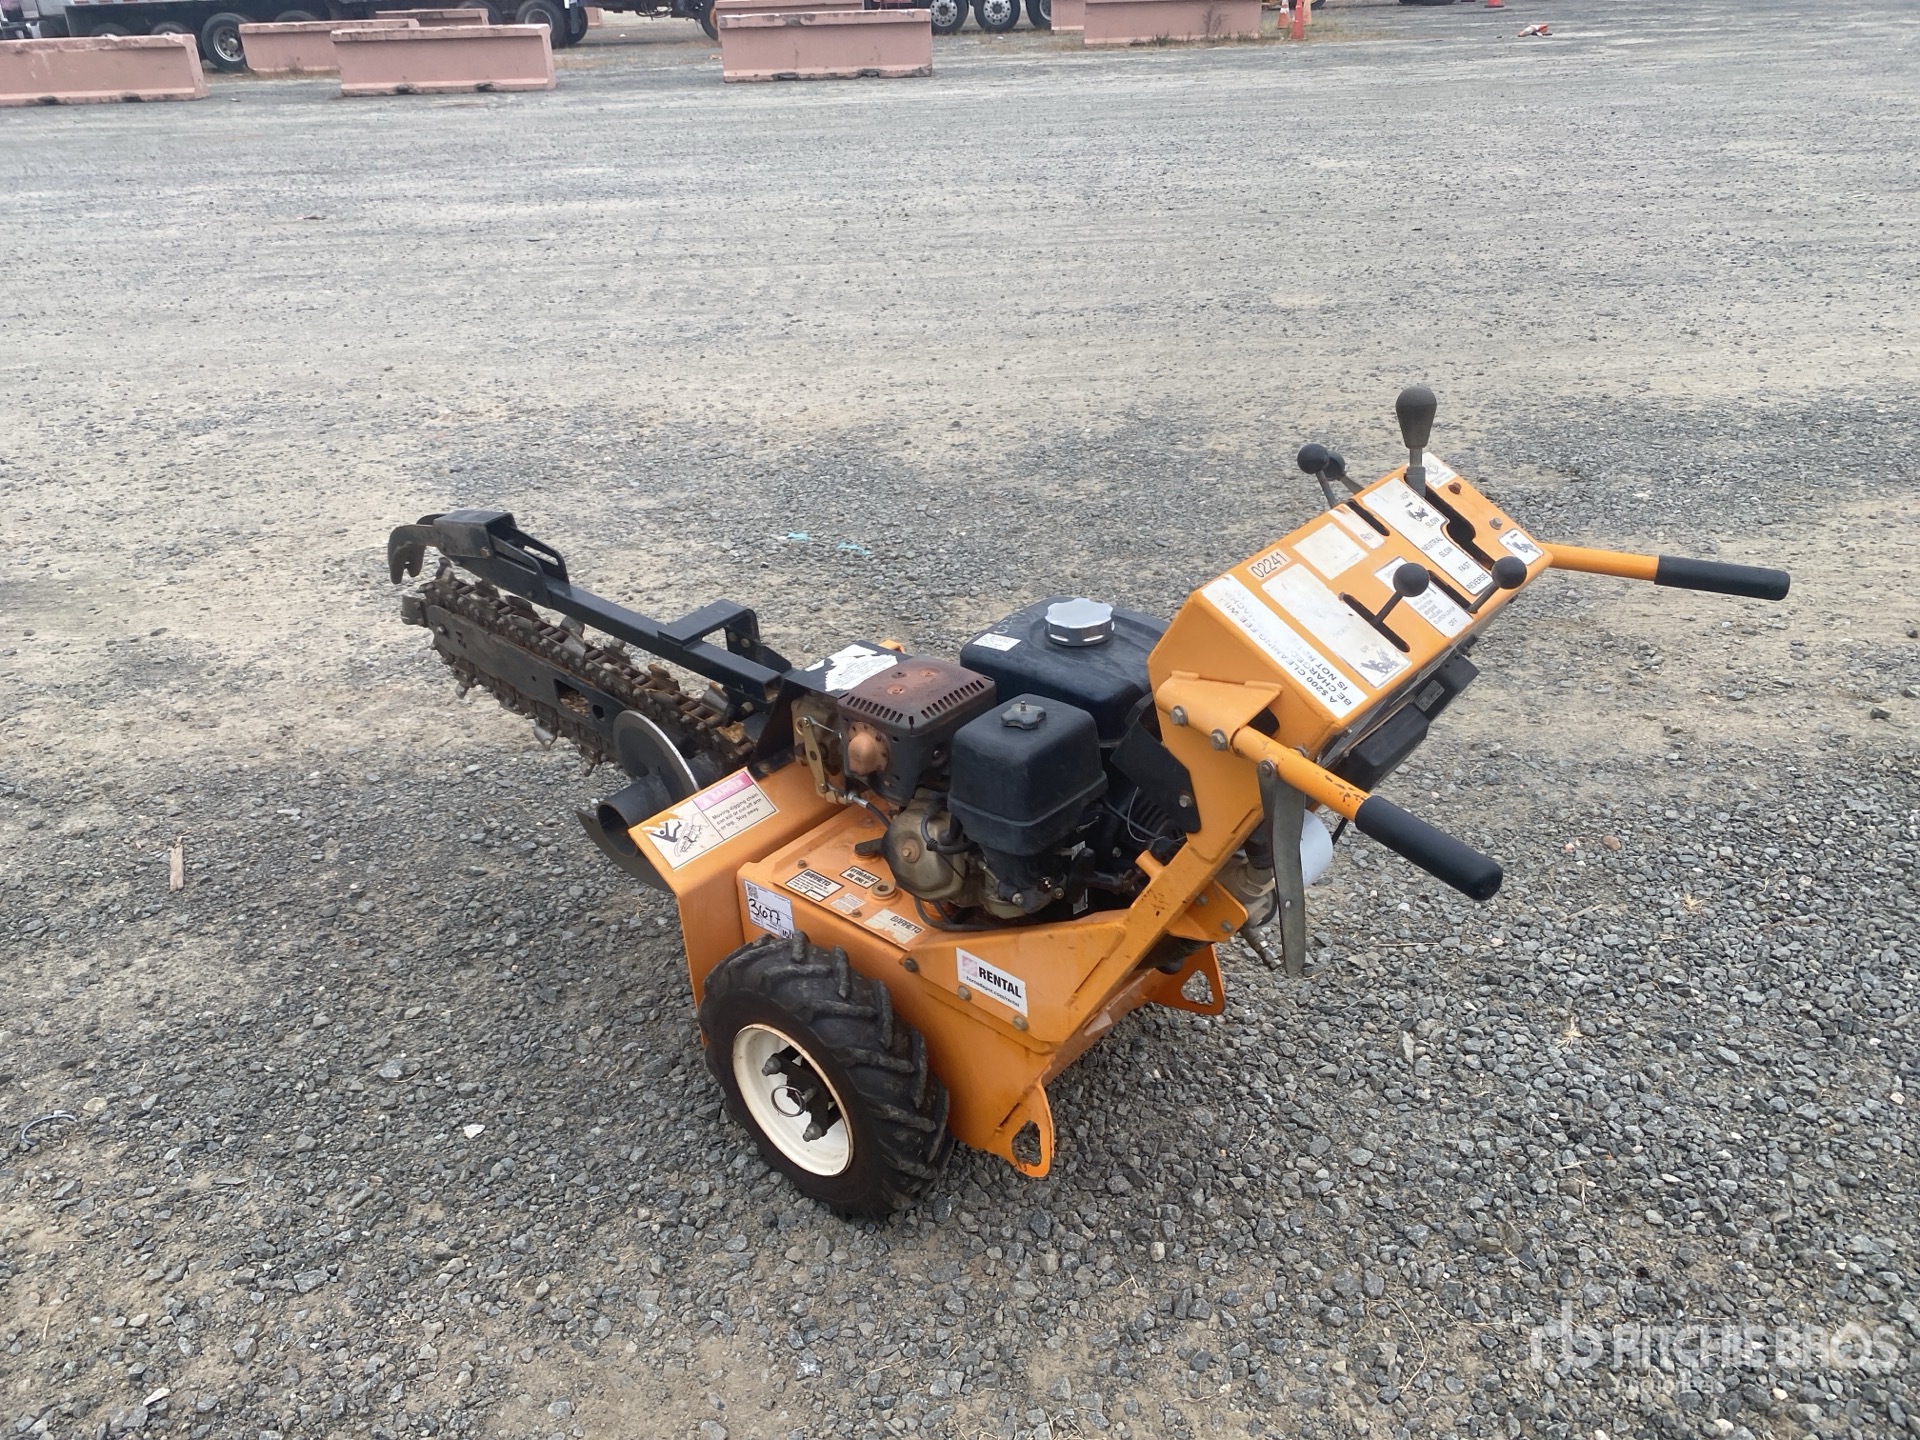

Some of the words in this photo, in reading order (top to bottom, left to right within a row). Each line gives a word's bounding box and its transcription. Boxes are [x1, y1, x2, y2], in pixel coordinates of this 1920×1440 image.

[1421, 536, 1443, 551] NEUTRAL
[1438, 546, 1453, 558] SLOW
[1251, 552, 1288, 578] 02241
[1457, 561, 1471, 573] FAST
[1466, 572, 1488, 590] REVERSE
[1239, 615, 1258, 633] FEE
[1447, 617, 1458, 626] OFF
[1257, 633, 1306, 676] CLEANING
[1315, 662, 1337, 681] NOT
[1306, 676, 1329, 696] $200
[1337, 681, 1348, 691] IS
[1329, 695, 1338, 704] A
[1336, 692, 1352, 706] BE
[711, 809, 730, 820] Moving
[729, 799, 747, 811] digging
[746, 793, 759, 802] chain
[735, 813, 748, 821] Stay
[804, 870, 831, 887] BARRETO
[890, 915, 923, 934] BARRETO
[979, 966, 1022, 998] RENTAL
